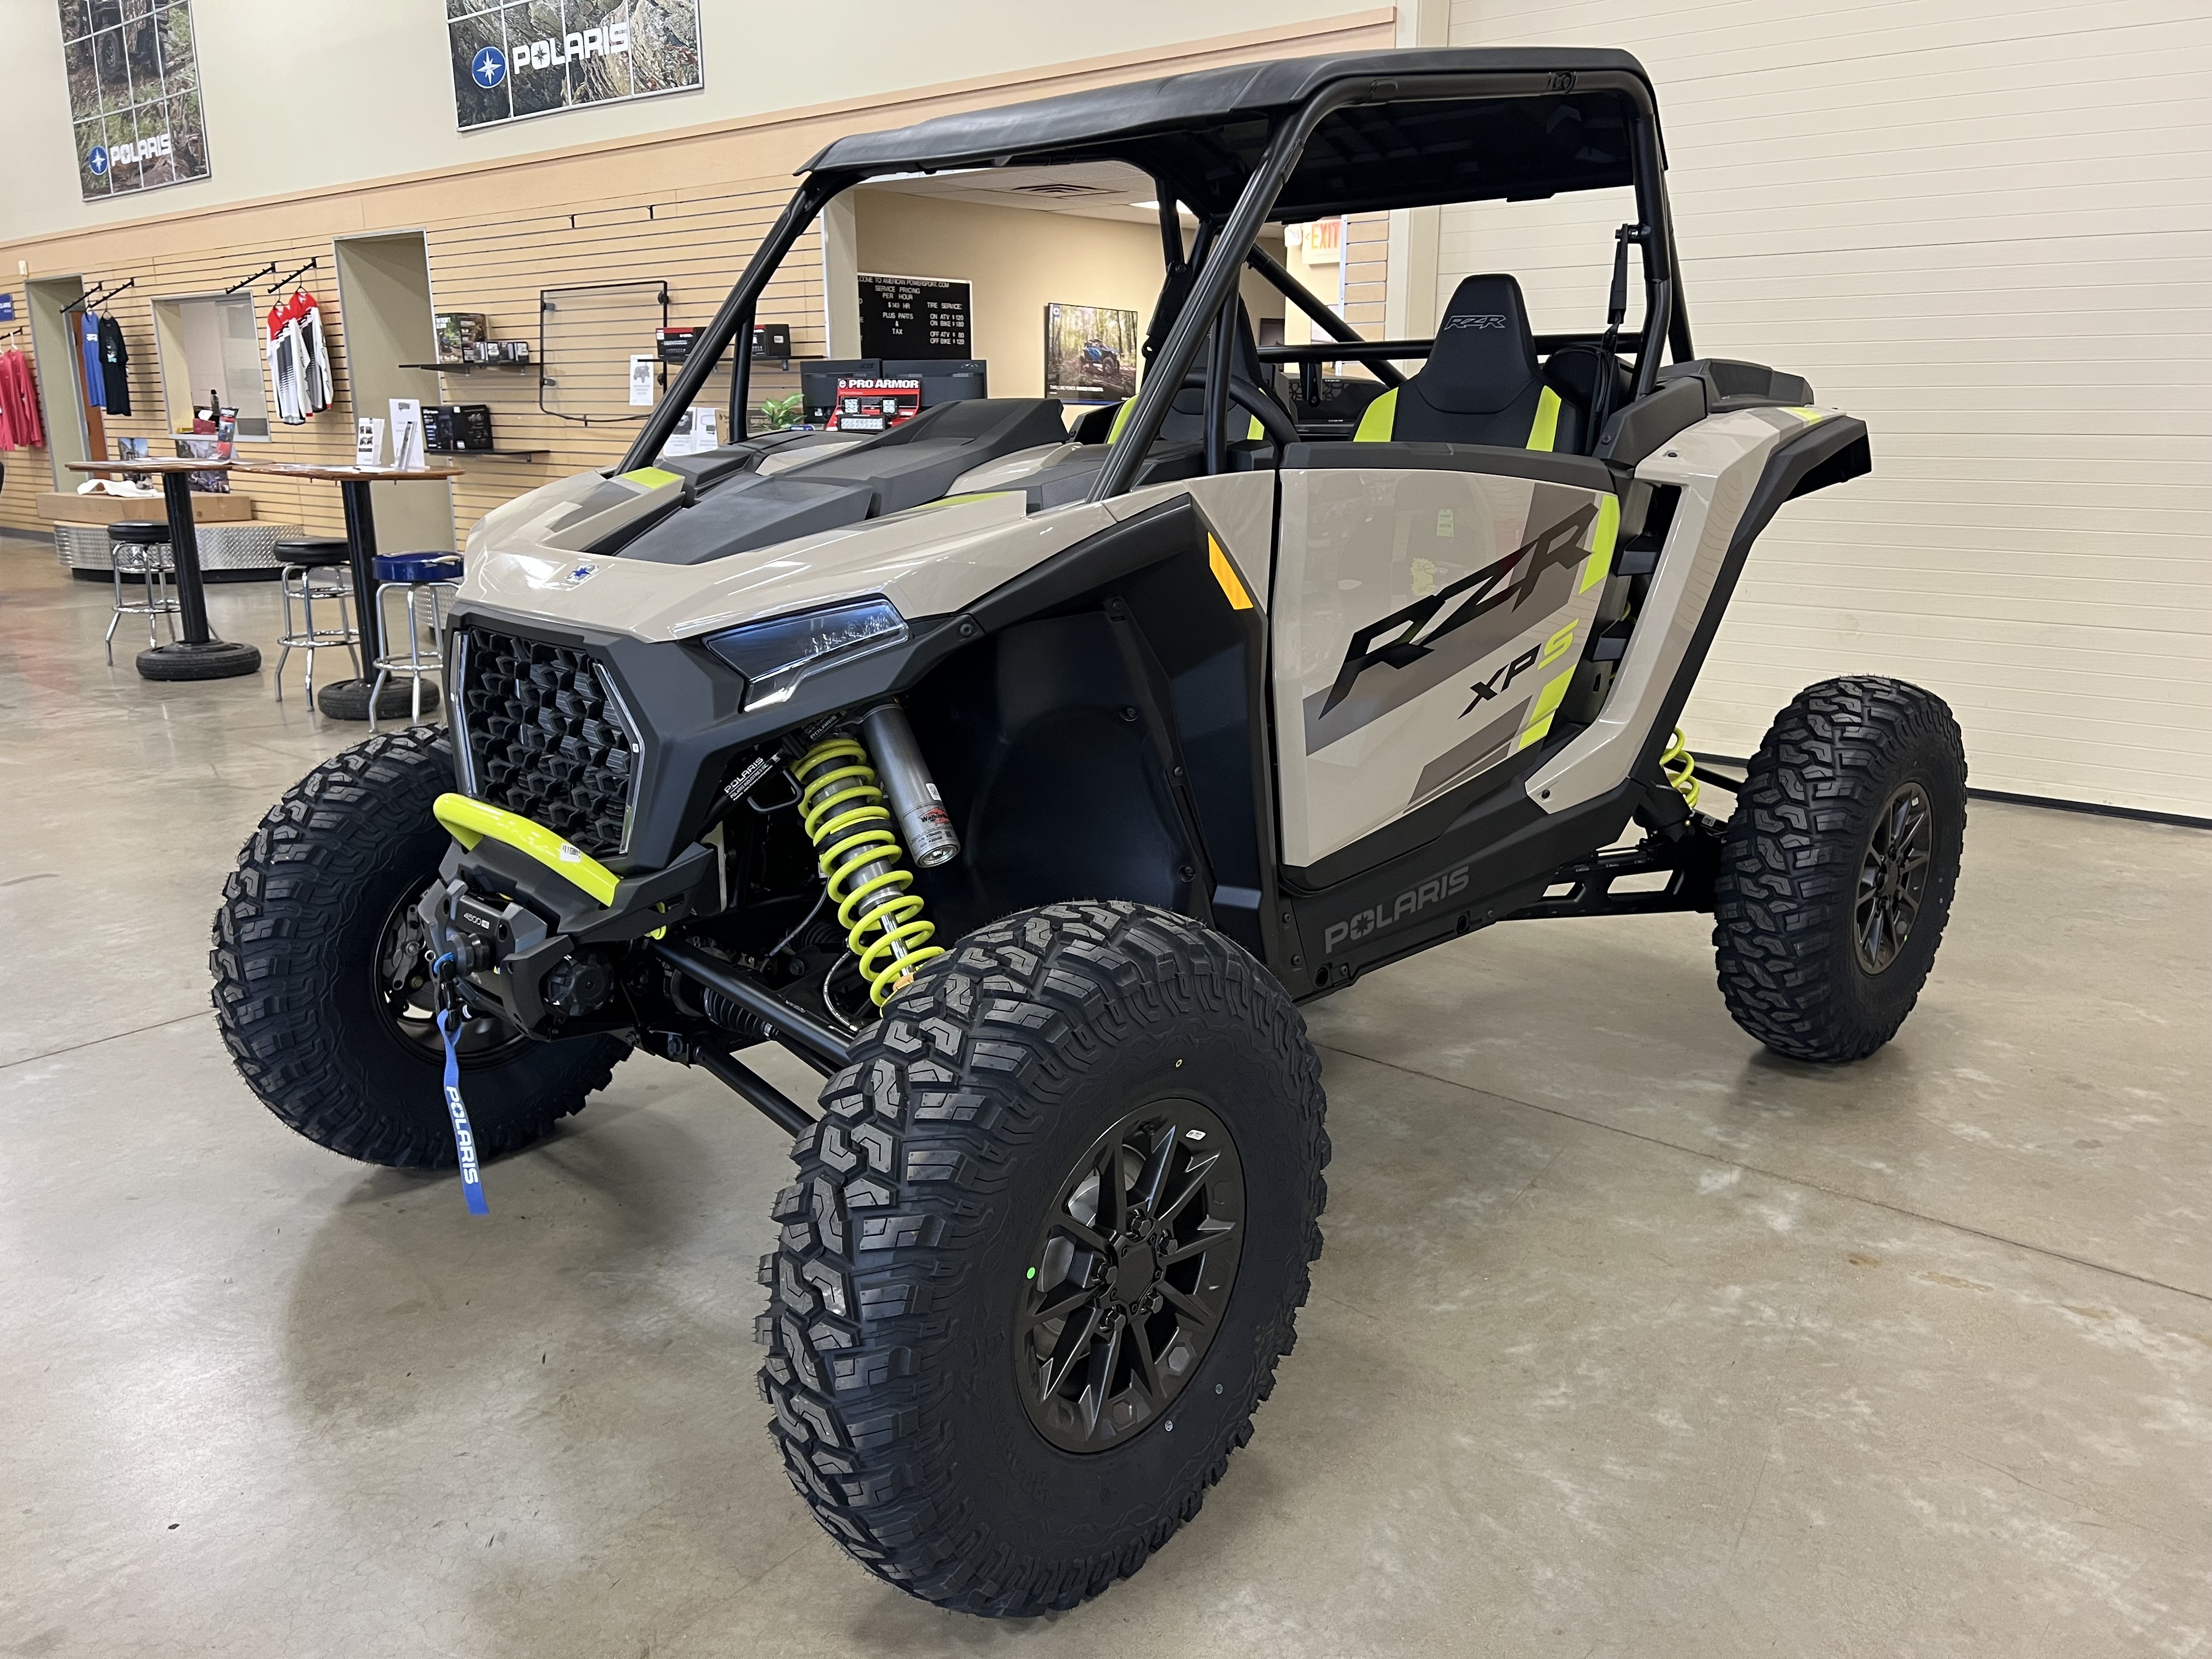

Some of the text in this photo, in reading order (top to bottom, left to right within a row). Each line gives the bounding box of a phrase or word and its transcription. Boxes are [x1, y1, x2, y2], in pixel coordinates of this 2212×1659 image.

[512, 22, 629, 75] POLARIS
[110, 133, 172, 167] POLARIS
[1312, 222, 1341, 249] EXIT
[1443, 314, 1506, 330] RZR
[849, 380, 919, 388] PRO ARMOR
[1318, 503, 1599, 720] RZR
[810, 715, 837, 739] POLARIS
[724, 757, 764, 793] POLARIS
[464, 912, 482, 926] 4500
[1325, 864, 1469, 954] POLARIS
[446, 1086, 479, 1184] POLARIS
